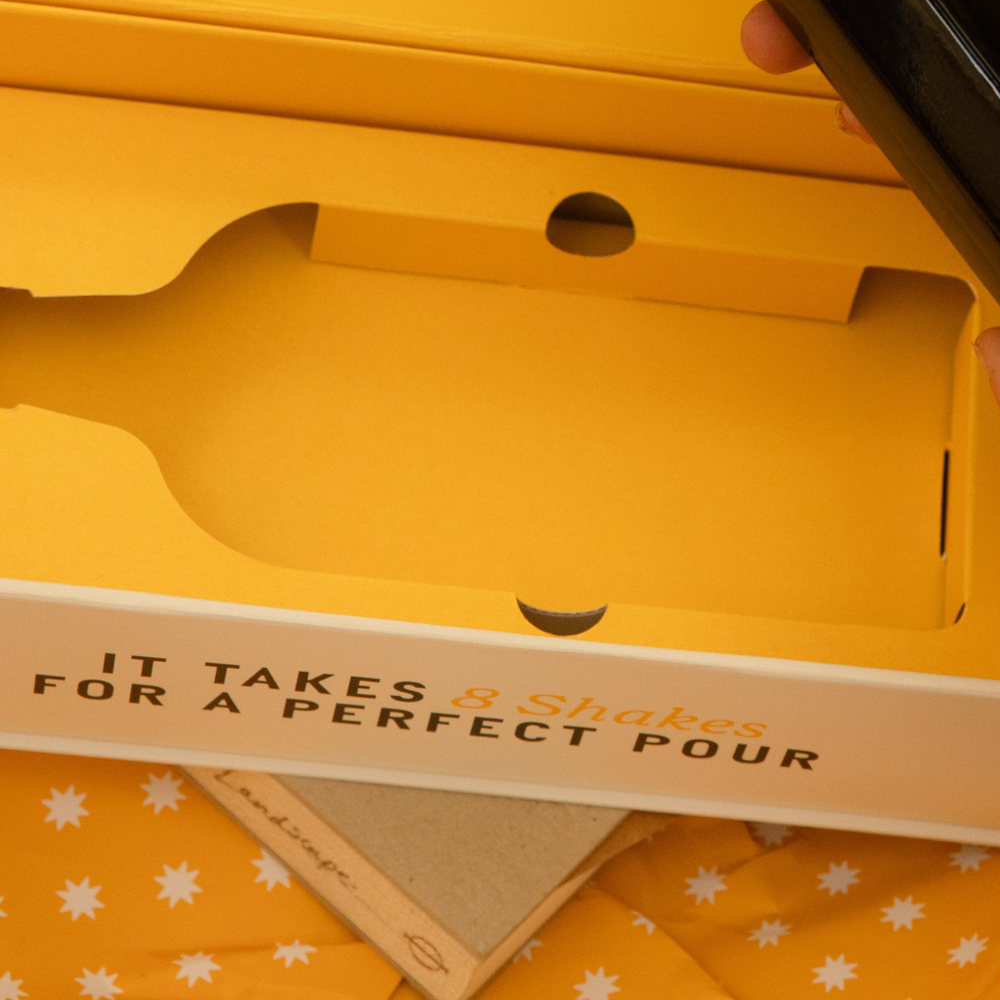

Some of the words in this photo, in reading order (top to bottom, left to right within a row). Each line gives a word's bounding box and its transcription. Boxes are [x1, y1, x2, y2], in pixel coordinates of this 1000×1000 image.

[33, 674, 167, 706] FOR
[202, 692, 241, 714] A
[282, 698, 597, 747] PERFECT
[632, 733, 820, 771] POUR
[102, 653, 166, 678] IT
[204, 662, 427, 703] TAKES
[450, 687, 501, 710] 8
[516, 693, 768, 739] Shakes
